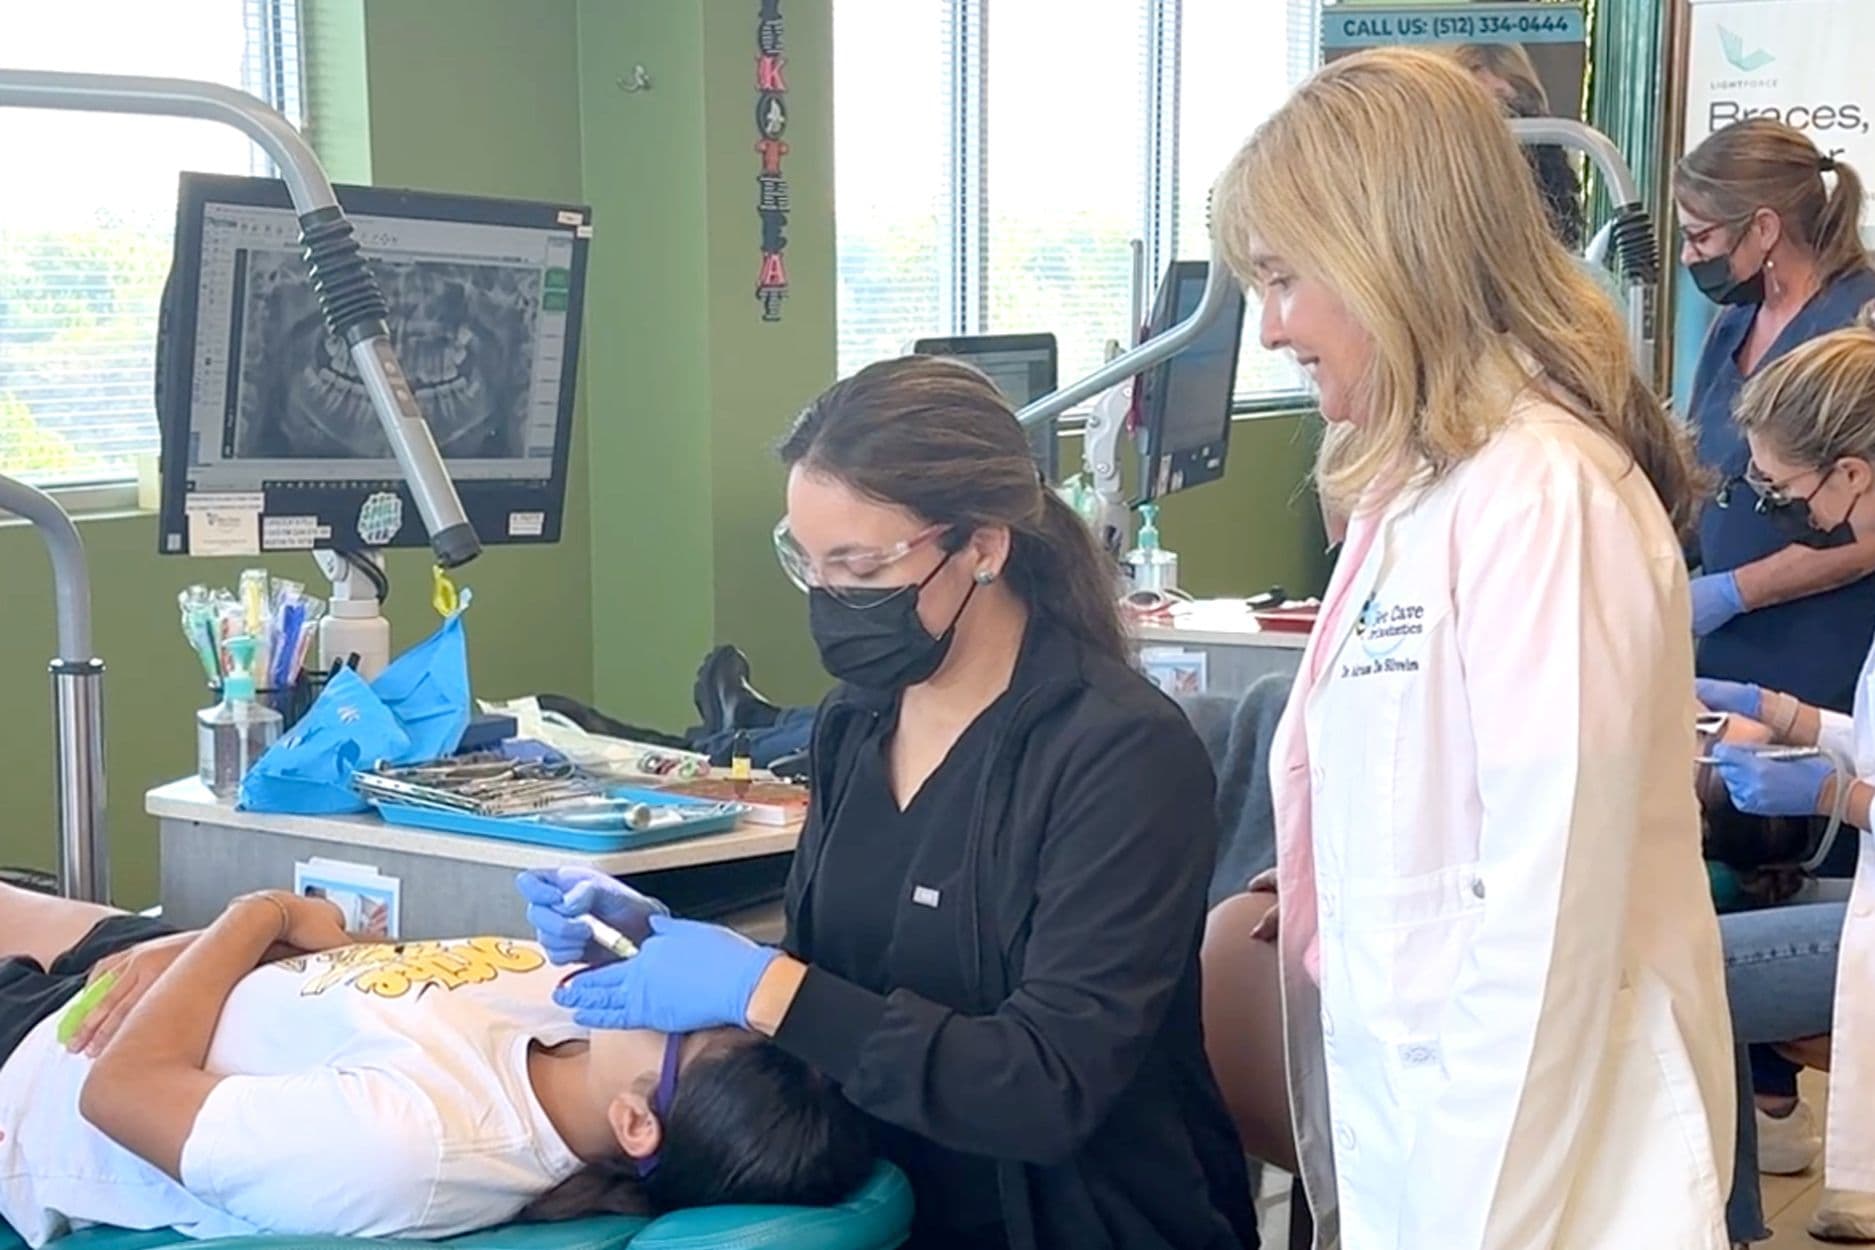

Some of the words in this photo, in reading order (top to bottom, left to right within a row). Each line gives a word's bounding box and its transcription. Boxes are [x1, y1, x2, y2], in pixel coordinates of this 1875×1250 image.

[1344, 19, 1392, 36] CALL
[1397, 18, 1428, 35] US:
[1433, 16, 1474, 38] (512)
[1480, 16, 1568, 33] 334-0444
[1709, 101, 1869, 133] Braces,
